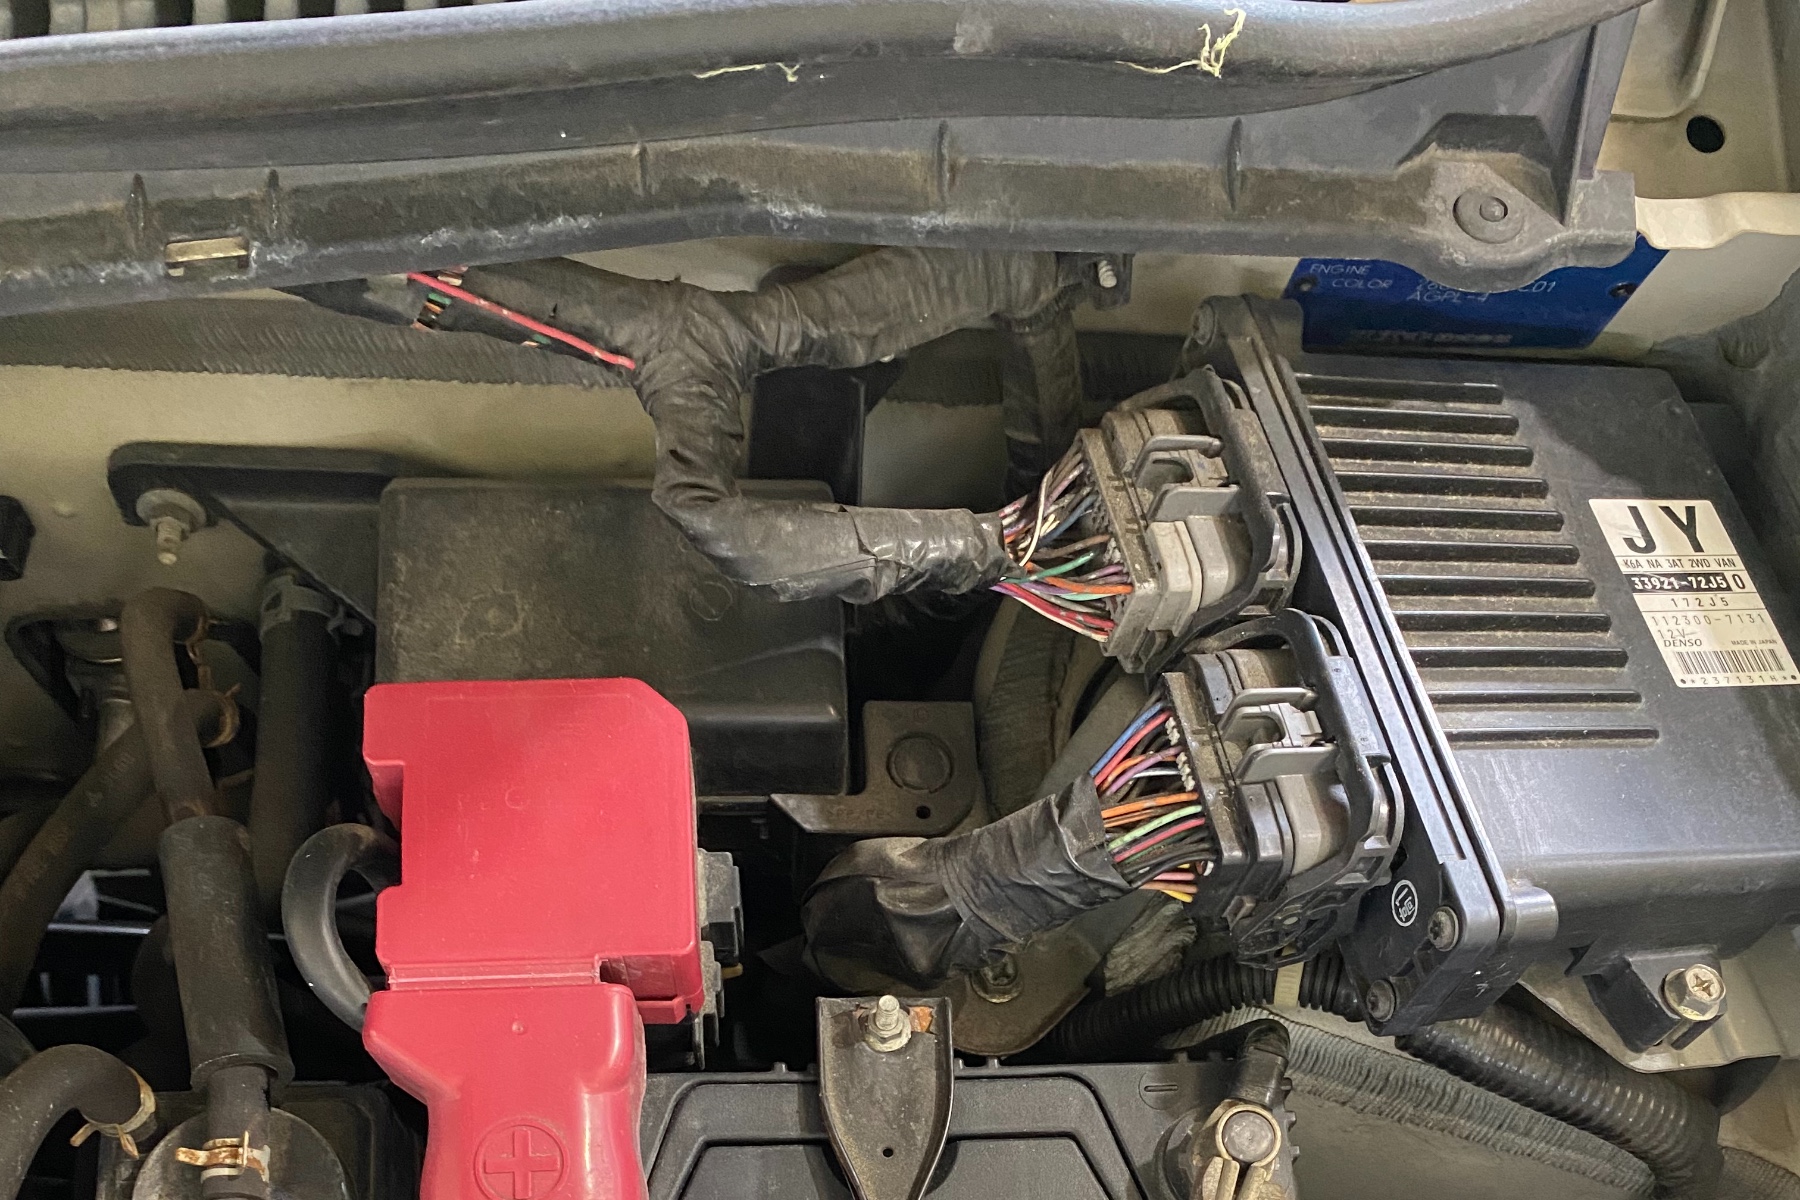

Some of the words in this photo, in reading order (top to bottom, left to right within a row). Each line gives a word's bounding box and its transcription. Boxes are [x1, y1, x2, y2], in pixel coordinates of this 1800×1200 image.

[1309, 264, 1371, 276] ENGINE
[1331, 278, 1393, 290] COLOR
[1646, 559, 1664, 568] NA
[1666, 558, 1685, 568] 3AT
[1688, 558, 1711, 567] 2WD
[1714, 558, 1737, 567] VAN
[1664, 639, 1703, 647] DENSO
